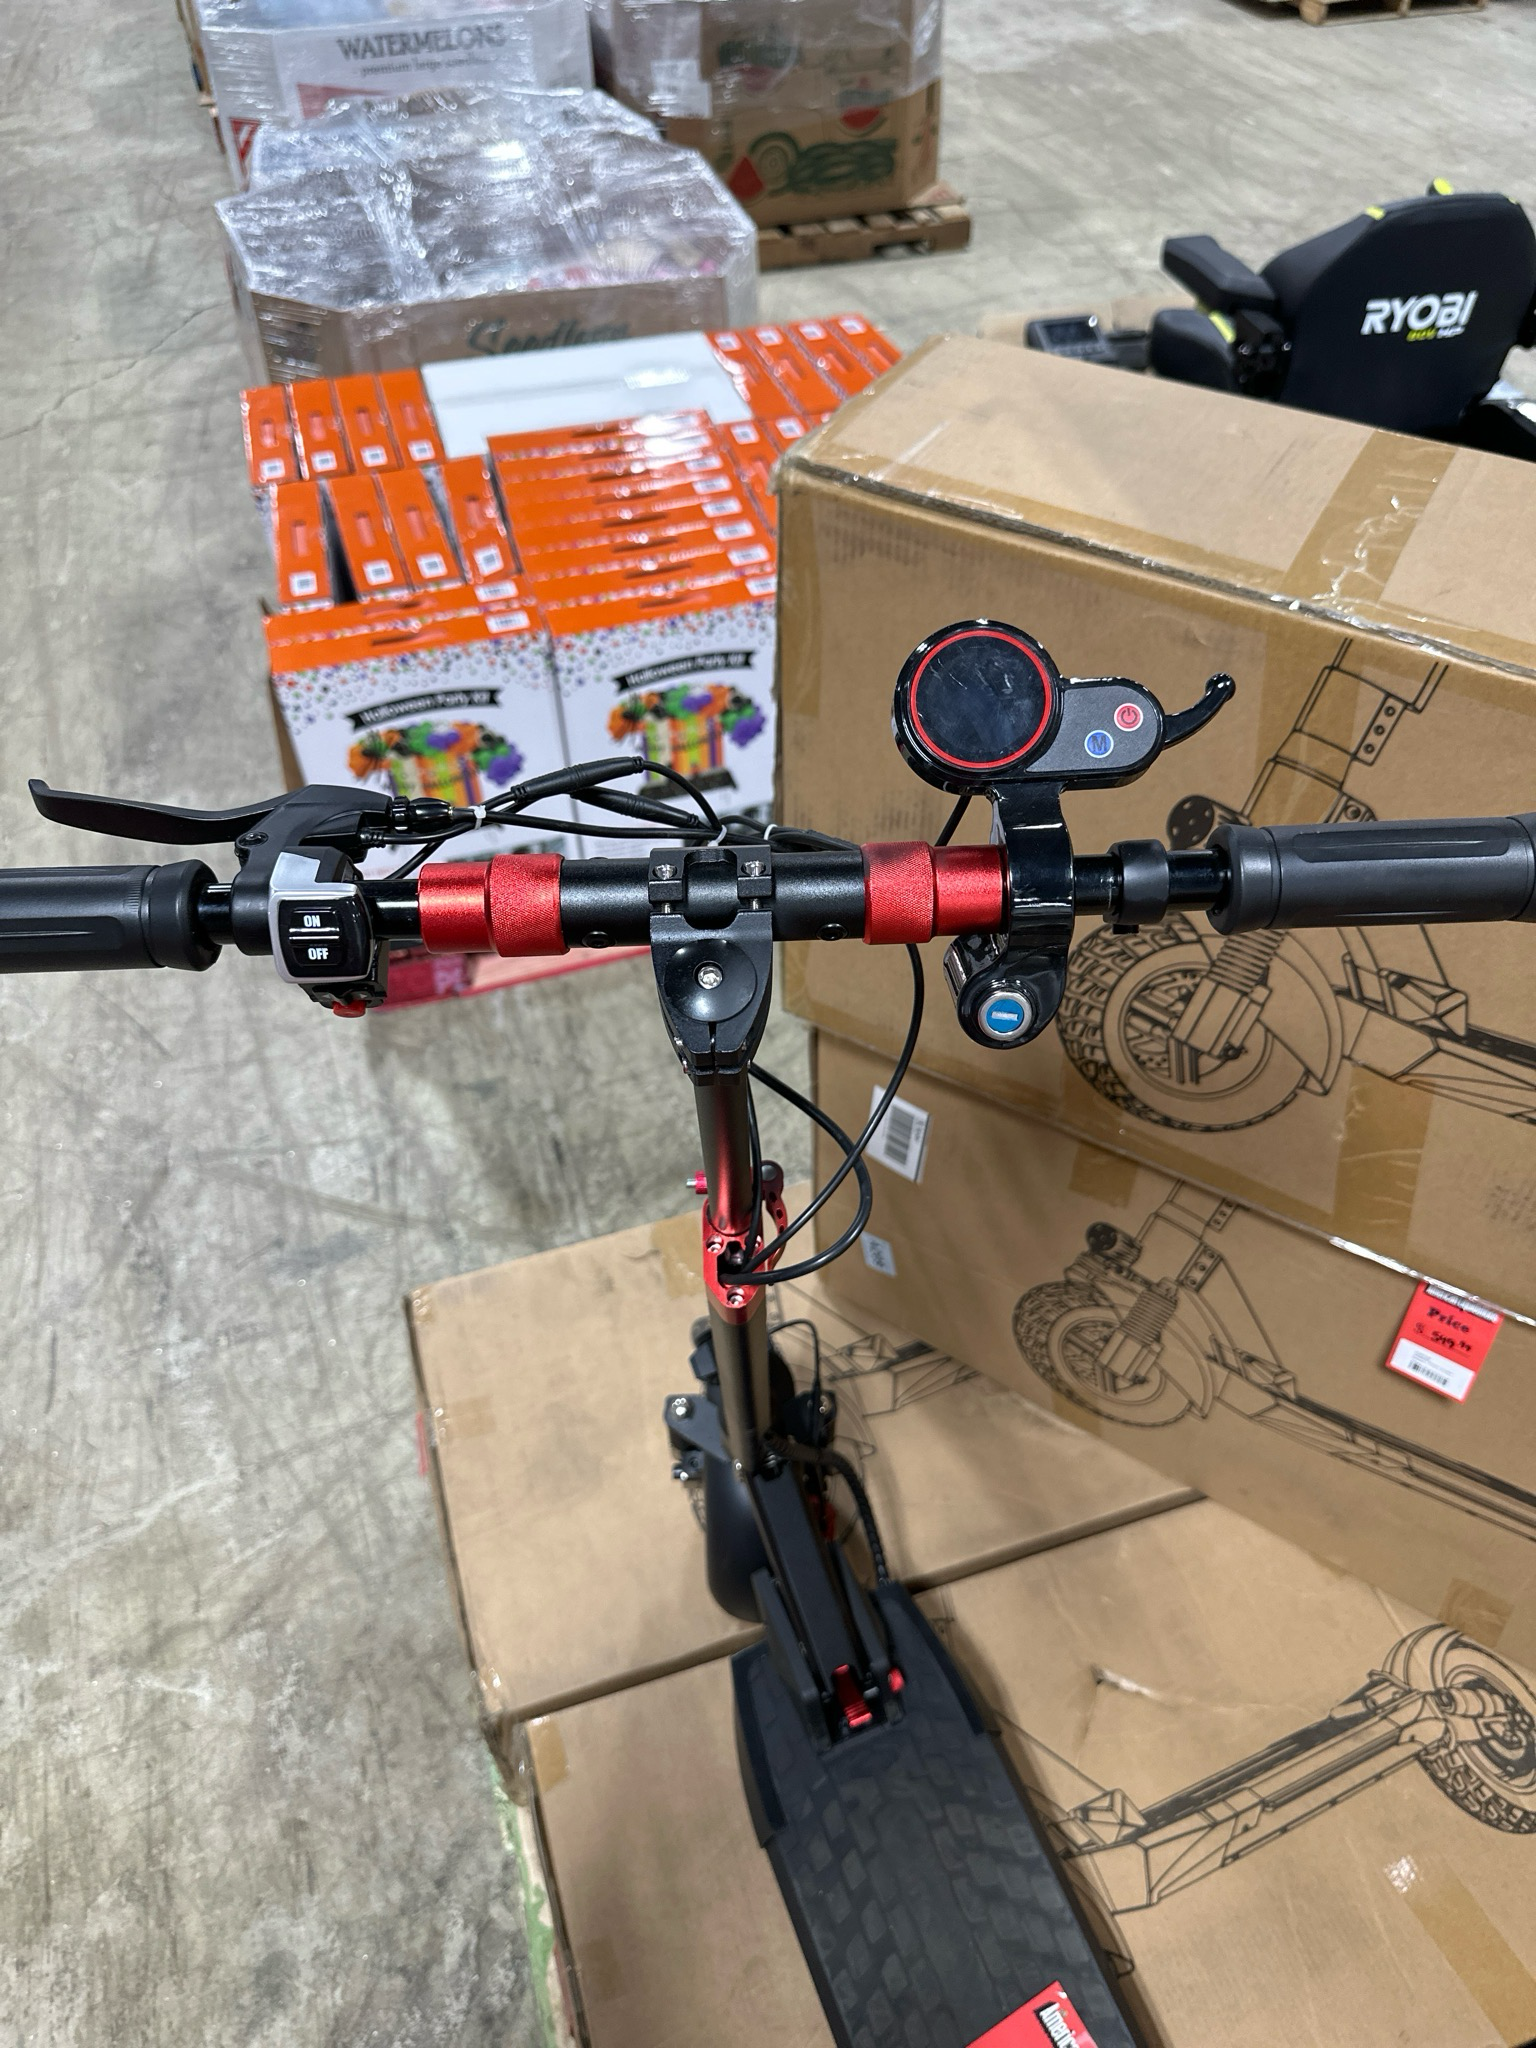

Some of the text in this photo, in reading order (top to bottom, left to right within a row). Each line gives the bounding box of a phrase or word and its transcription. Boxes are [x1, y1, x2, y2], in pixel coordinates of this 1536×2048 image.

[337, 24, 508, 60] WATERMELONS
[1360, 289, 1479, 336] RYOBI
[626, 657, 692, 687] Halloween
[693, 654, 726, 670] Party
[360, 696, 433, 725] Halloween
[434, 690, 470, 709] Party
[1091, 734, 1108, 752] M
[303, 914, 321, 928] ON
[307, 947, 329, 960] OFF
[1426, 1306, 1470, 1334] Price
[1039, 2001, 1081, 2048] Americ
